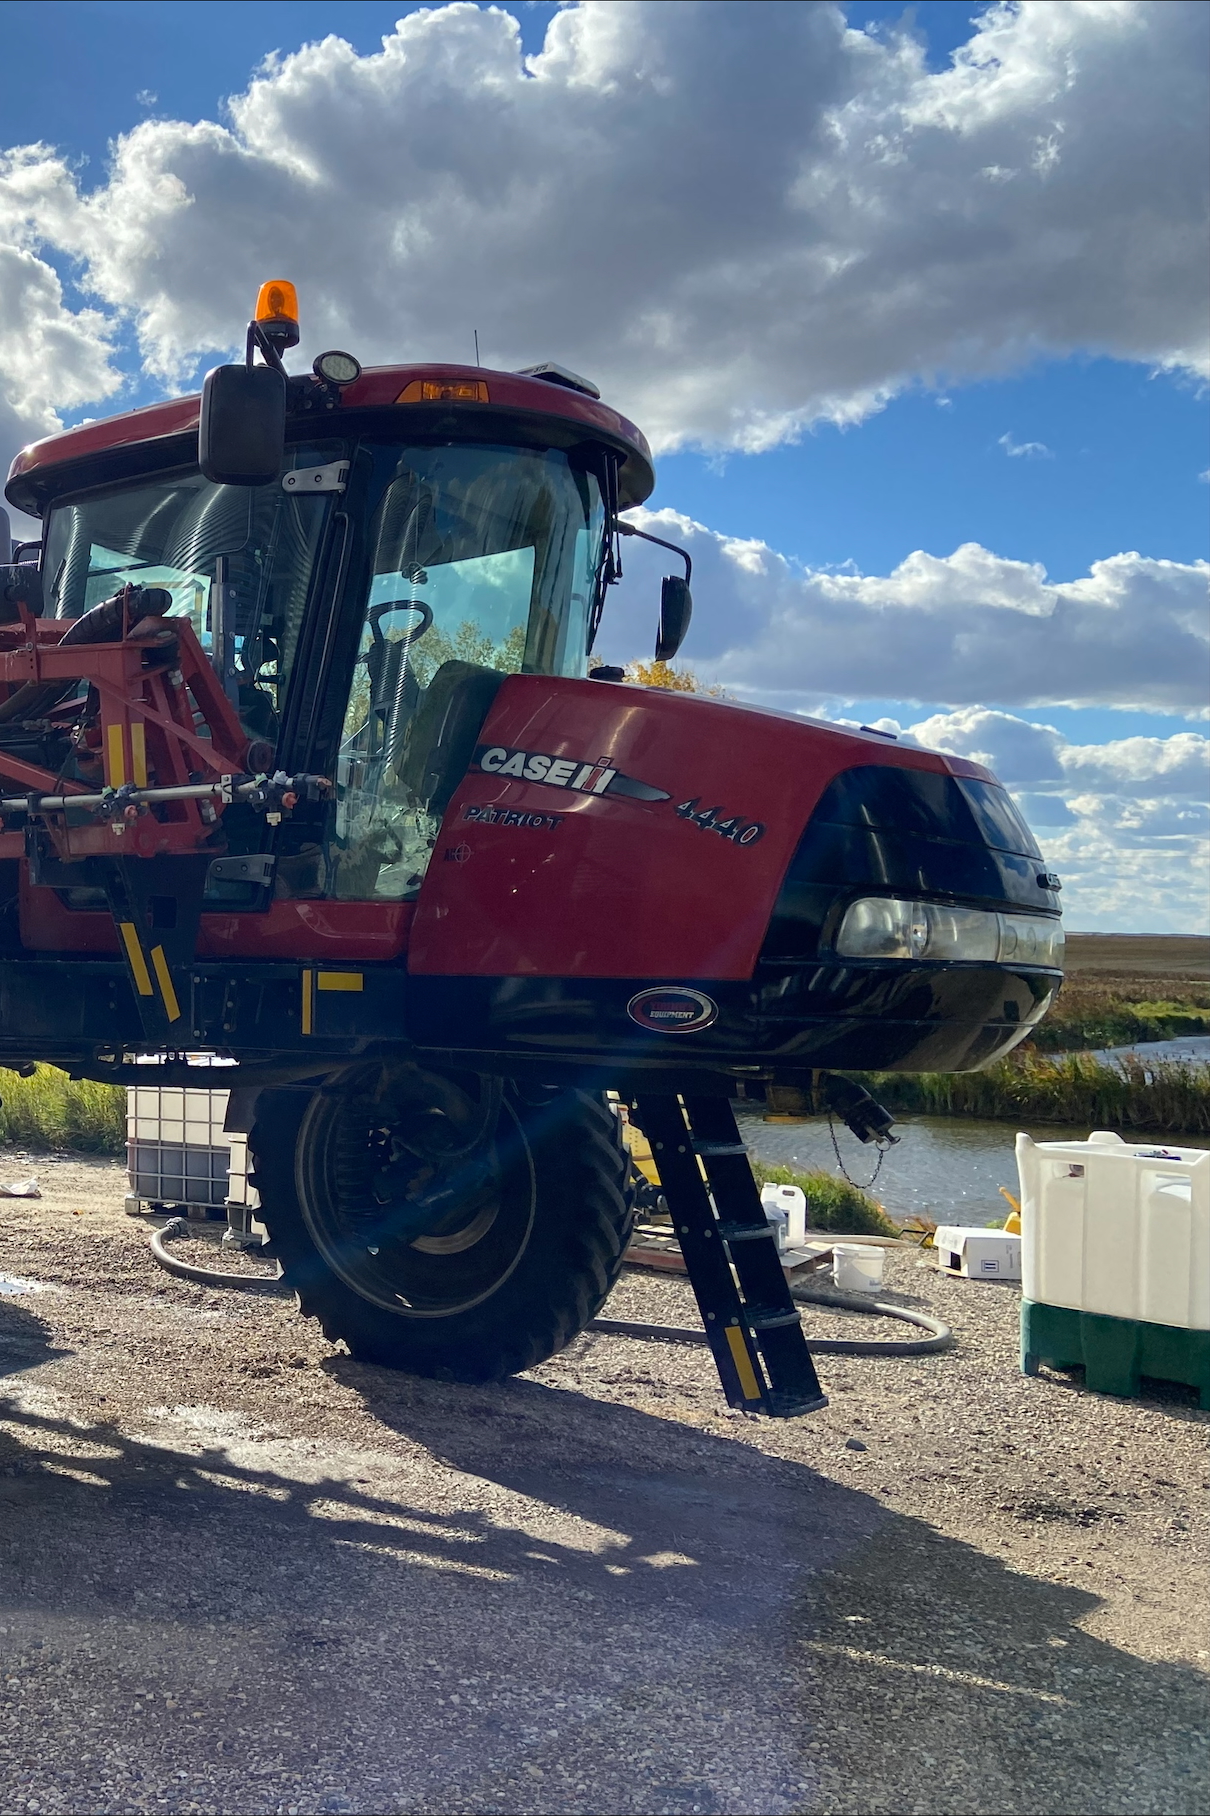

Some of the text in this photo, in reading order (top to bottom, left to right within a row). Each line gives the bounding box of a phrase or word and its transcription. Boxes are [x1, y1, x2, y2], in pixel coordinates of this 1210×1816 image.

[481, 747, 578, 786] CASE
[463, 806, 565, 831] PATRIOT
[674, 797, 767, 848] 4440
[649, 1010, 695, 1019] EQUIPMENT
